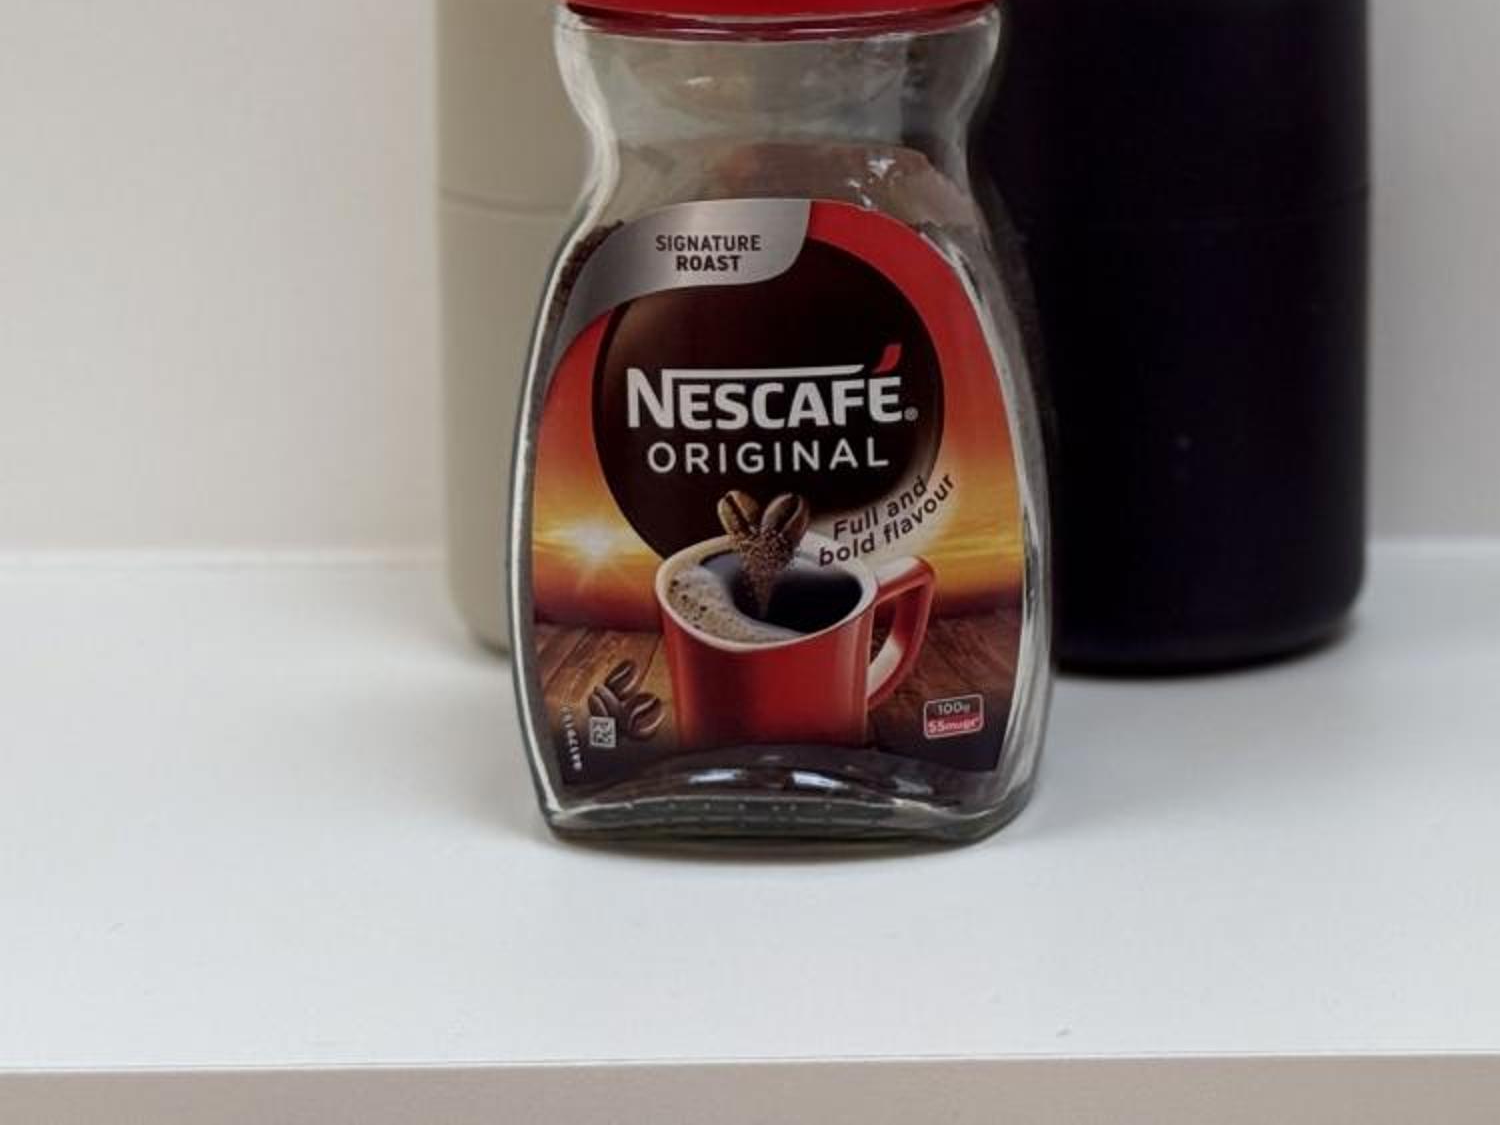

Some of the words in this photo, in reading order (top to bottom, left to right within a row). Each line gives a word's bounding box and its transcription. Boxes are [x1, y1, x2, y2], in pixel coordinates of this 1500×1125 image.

[655, 235, 761, 252] SIGNATURE
[676, 254, 741, 272] ROAST
[647, 436, 889, 474] ORIGINAL
[819, 533, 875, 567] bold
[883, 475, 954, 544] flavour
[833, 507, 878, 541] Full
[886, 475, 927, 518] and
